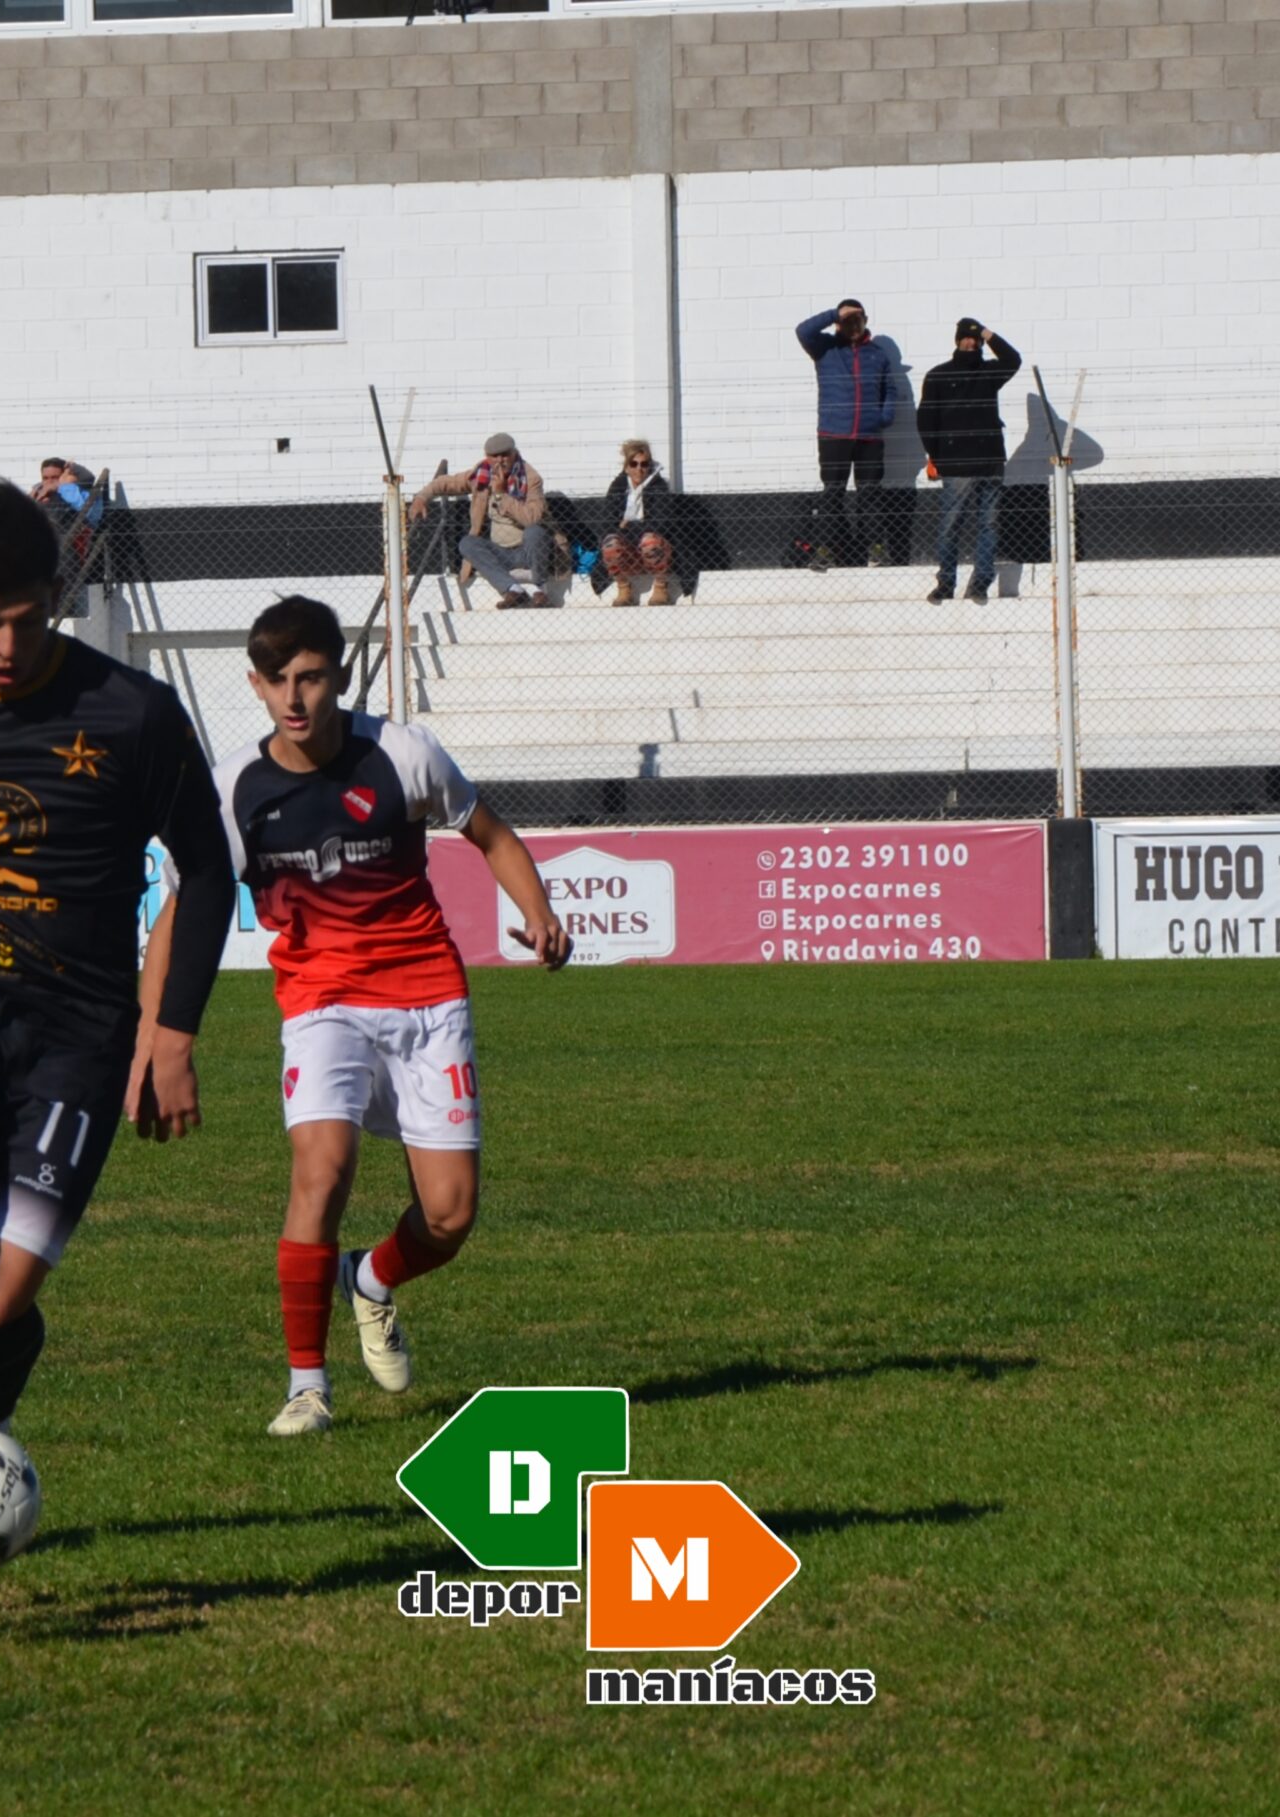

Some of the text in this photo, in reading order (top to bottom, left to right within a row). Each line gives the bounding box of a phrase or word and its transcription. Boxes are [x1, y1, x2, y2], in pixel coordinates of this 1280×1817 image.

[780, 843, 969, 869] 2302 391100
[1134, 845, 1264, 901] HUGO
[544, 876, 628, 900] EXPO
[781, 878, 941, 904] Expocarnes
[565, 911, 649, 935] RNES
[782, 909, 942, 935] Expocarnes
[783, 936, 981, 961] Rivadavia 430
[1169, 918, 1280, 954] CONT
[442, 1061, 477, 1100] 10
[36, 1101, 90, 1167] 11
